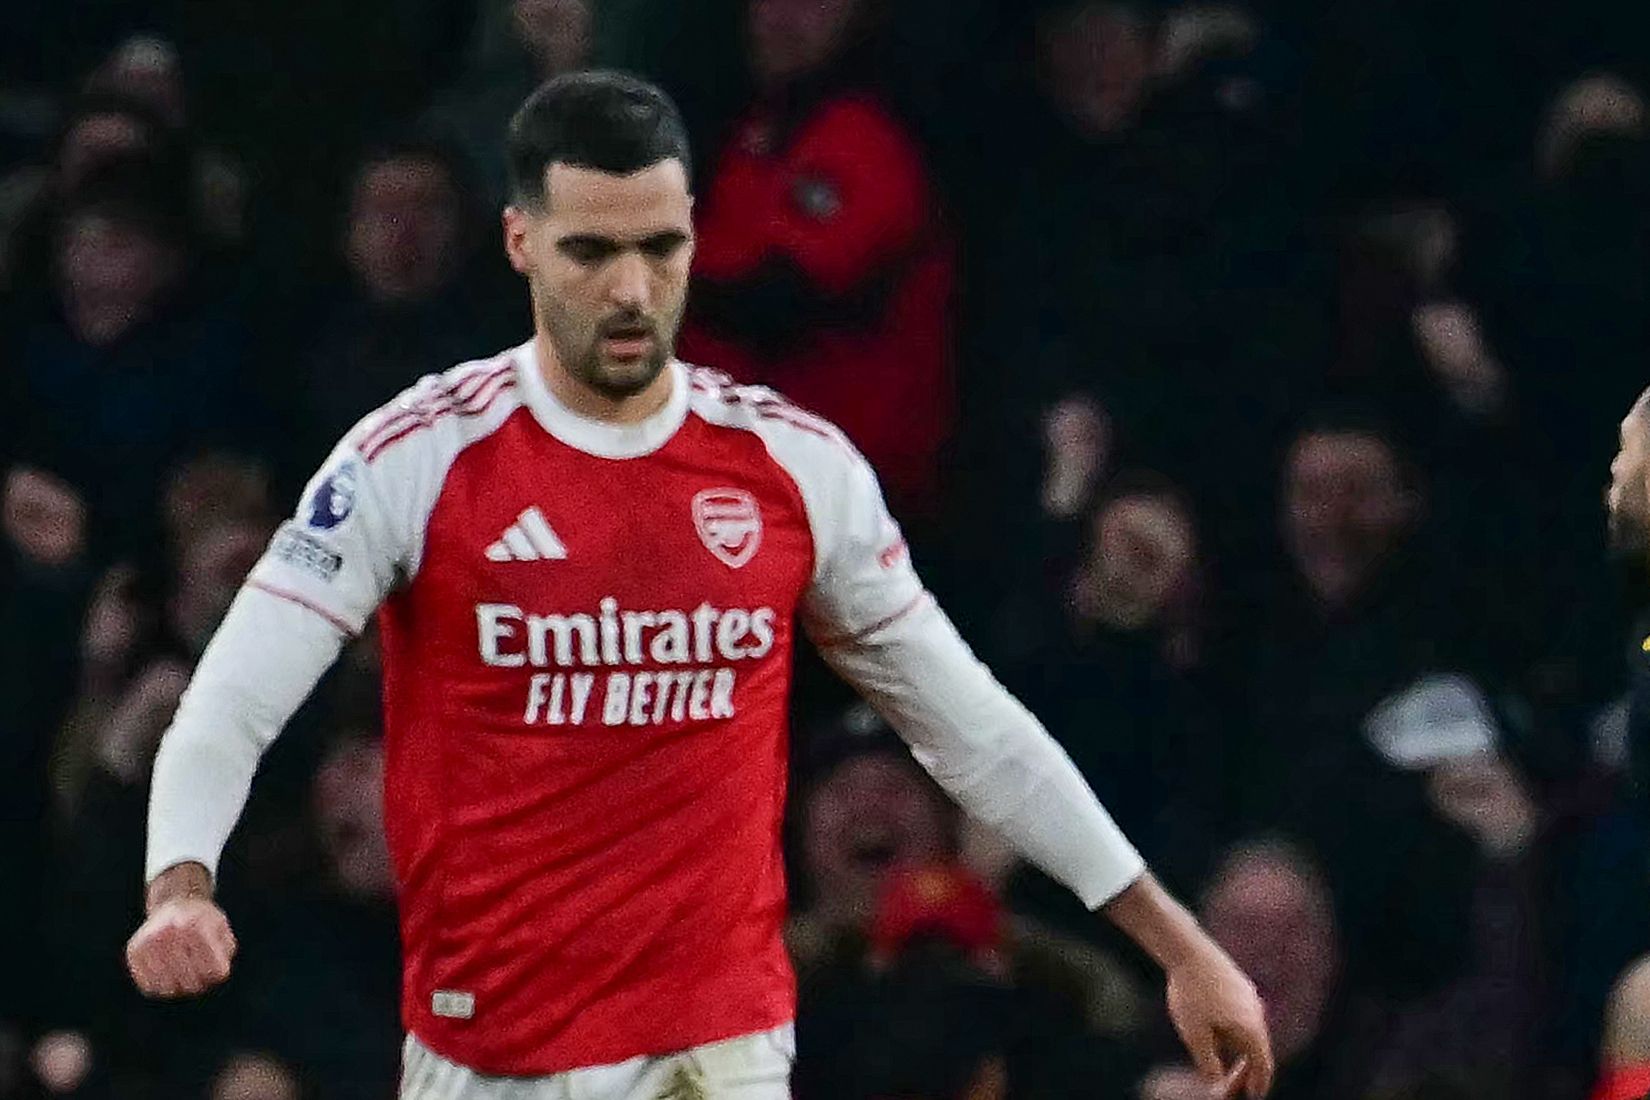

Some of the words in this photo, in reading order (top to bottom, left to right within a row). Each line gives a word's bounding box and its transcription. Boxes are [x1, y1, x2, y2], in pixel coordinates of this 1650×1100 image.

[475, 597, 775, 667] Emirates
[524, 671, 594, 726] FLY
[602, 667, 736, 726] BETTER
